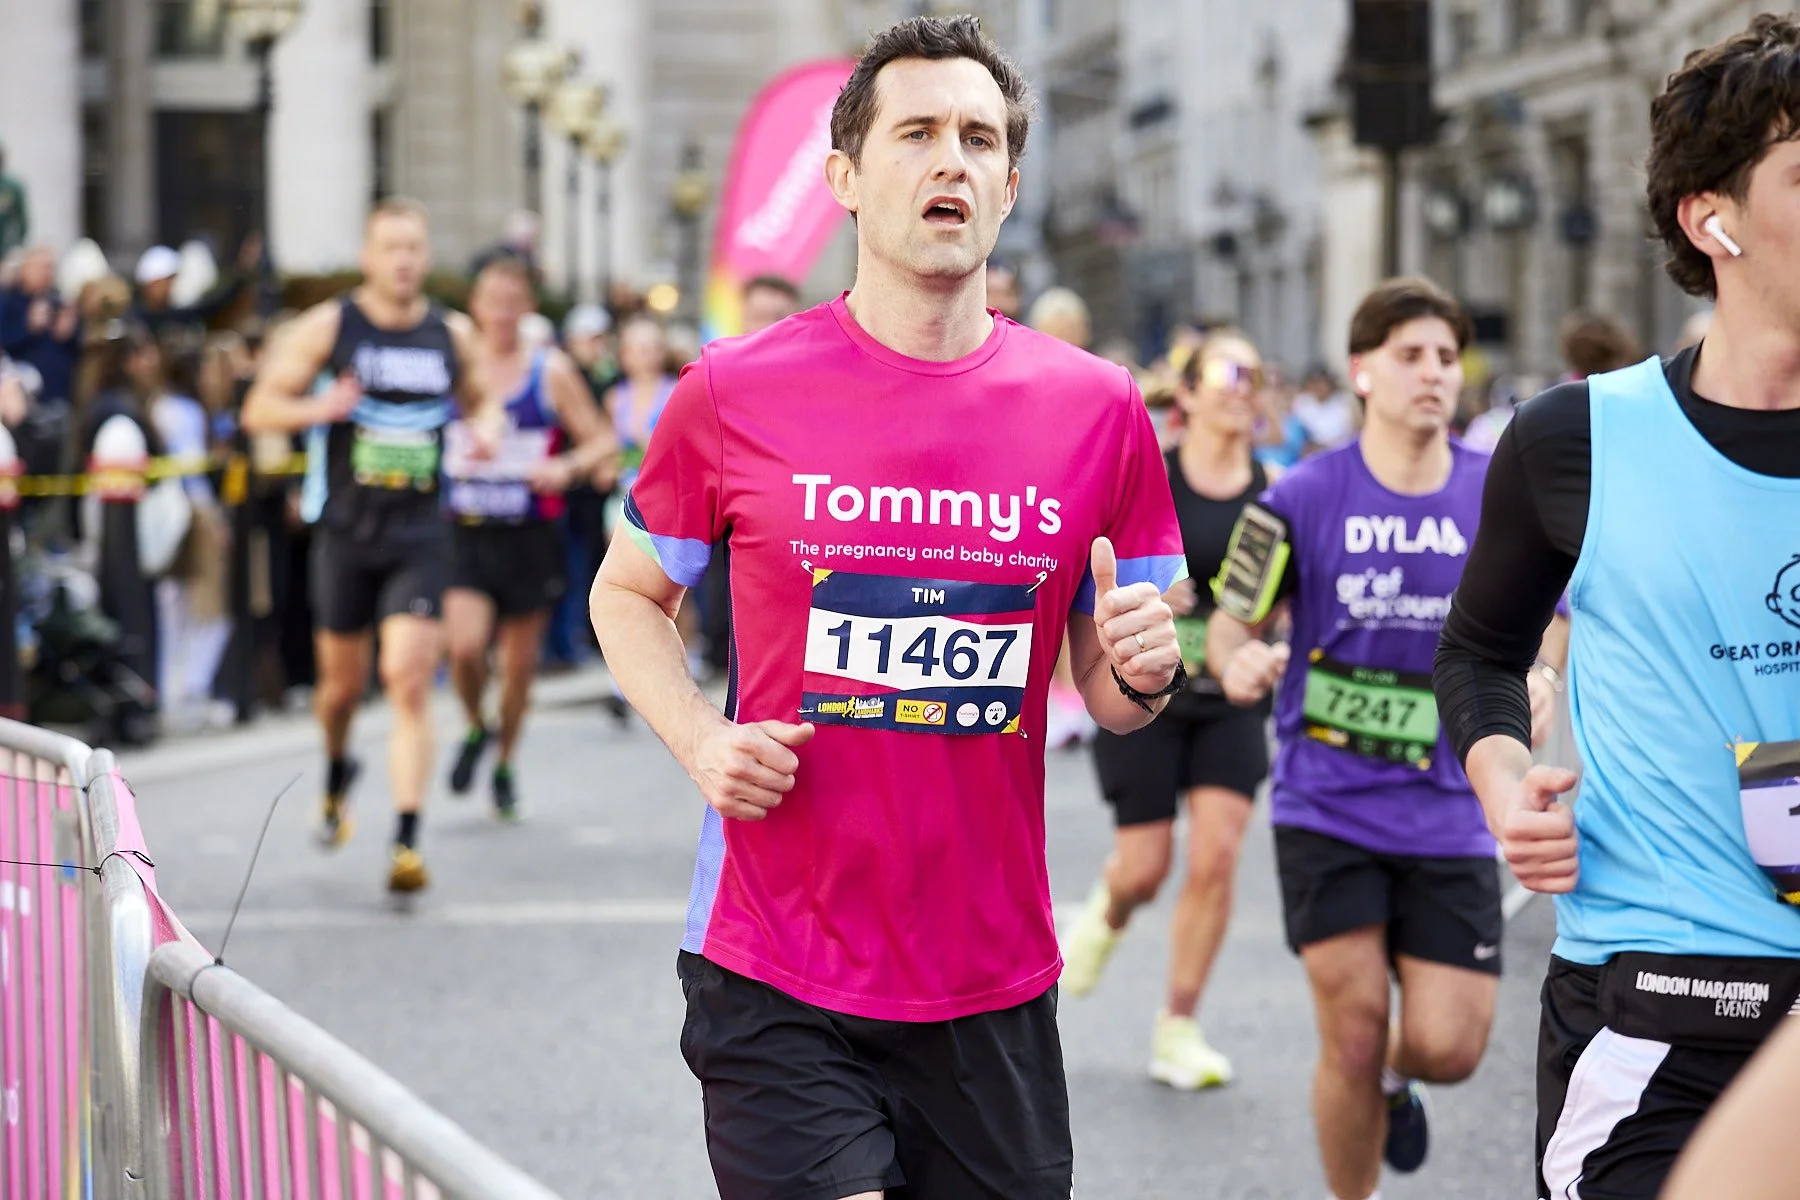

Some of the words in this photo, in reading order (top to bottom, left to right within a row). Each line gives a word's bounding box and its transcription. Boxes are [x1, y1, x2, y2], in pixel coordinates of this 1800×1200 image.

[792, 474, 1062, 543] Tommy's
[790, 541, 820, 556] The
[825, 543, 916, 562] pregnancy
[922, 545, 954, 561] and
[960, 545, 1004, 567] baby
[1009, 553, 1058, 572] charity
[911, 587, 945, 605] TIM
[827, 620, 1018, 680] 11467
[1710, 644, 1759, 661] GEAT
[817, 702, 847, 714] LONDON
[903, 704, 919, 713] NO
[992, 713, 999, 721] 4
[1328, 685, 1417, 729] 7247
[1635, 971, 1690, 997] LONDON
[1691, 978, 1769, 1002] MARATHON
[1714, 999, 1761, 1019] EVENTS
